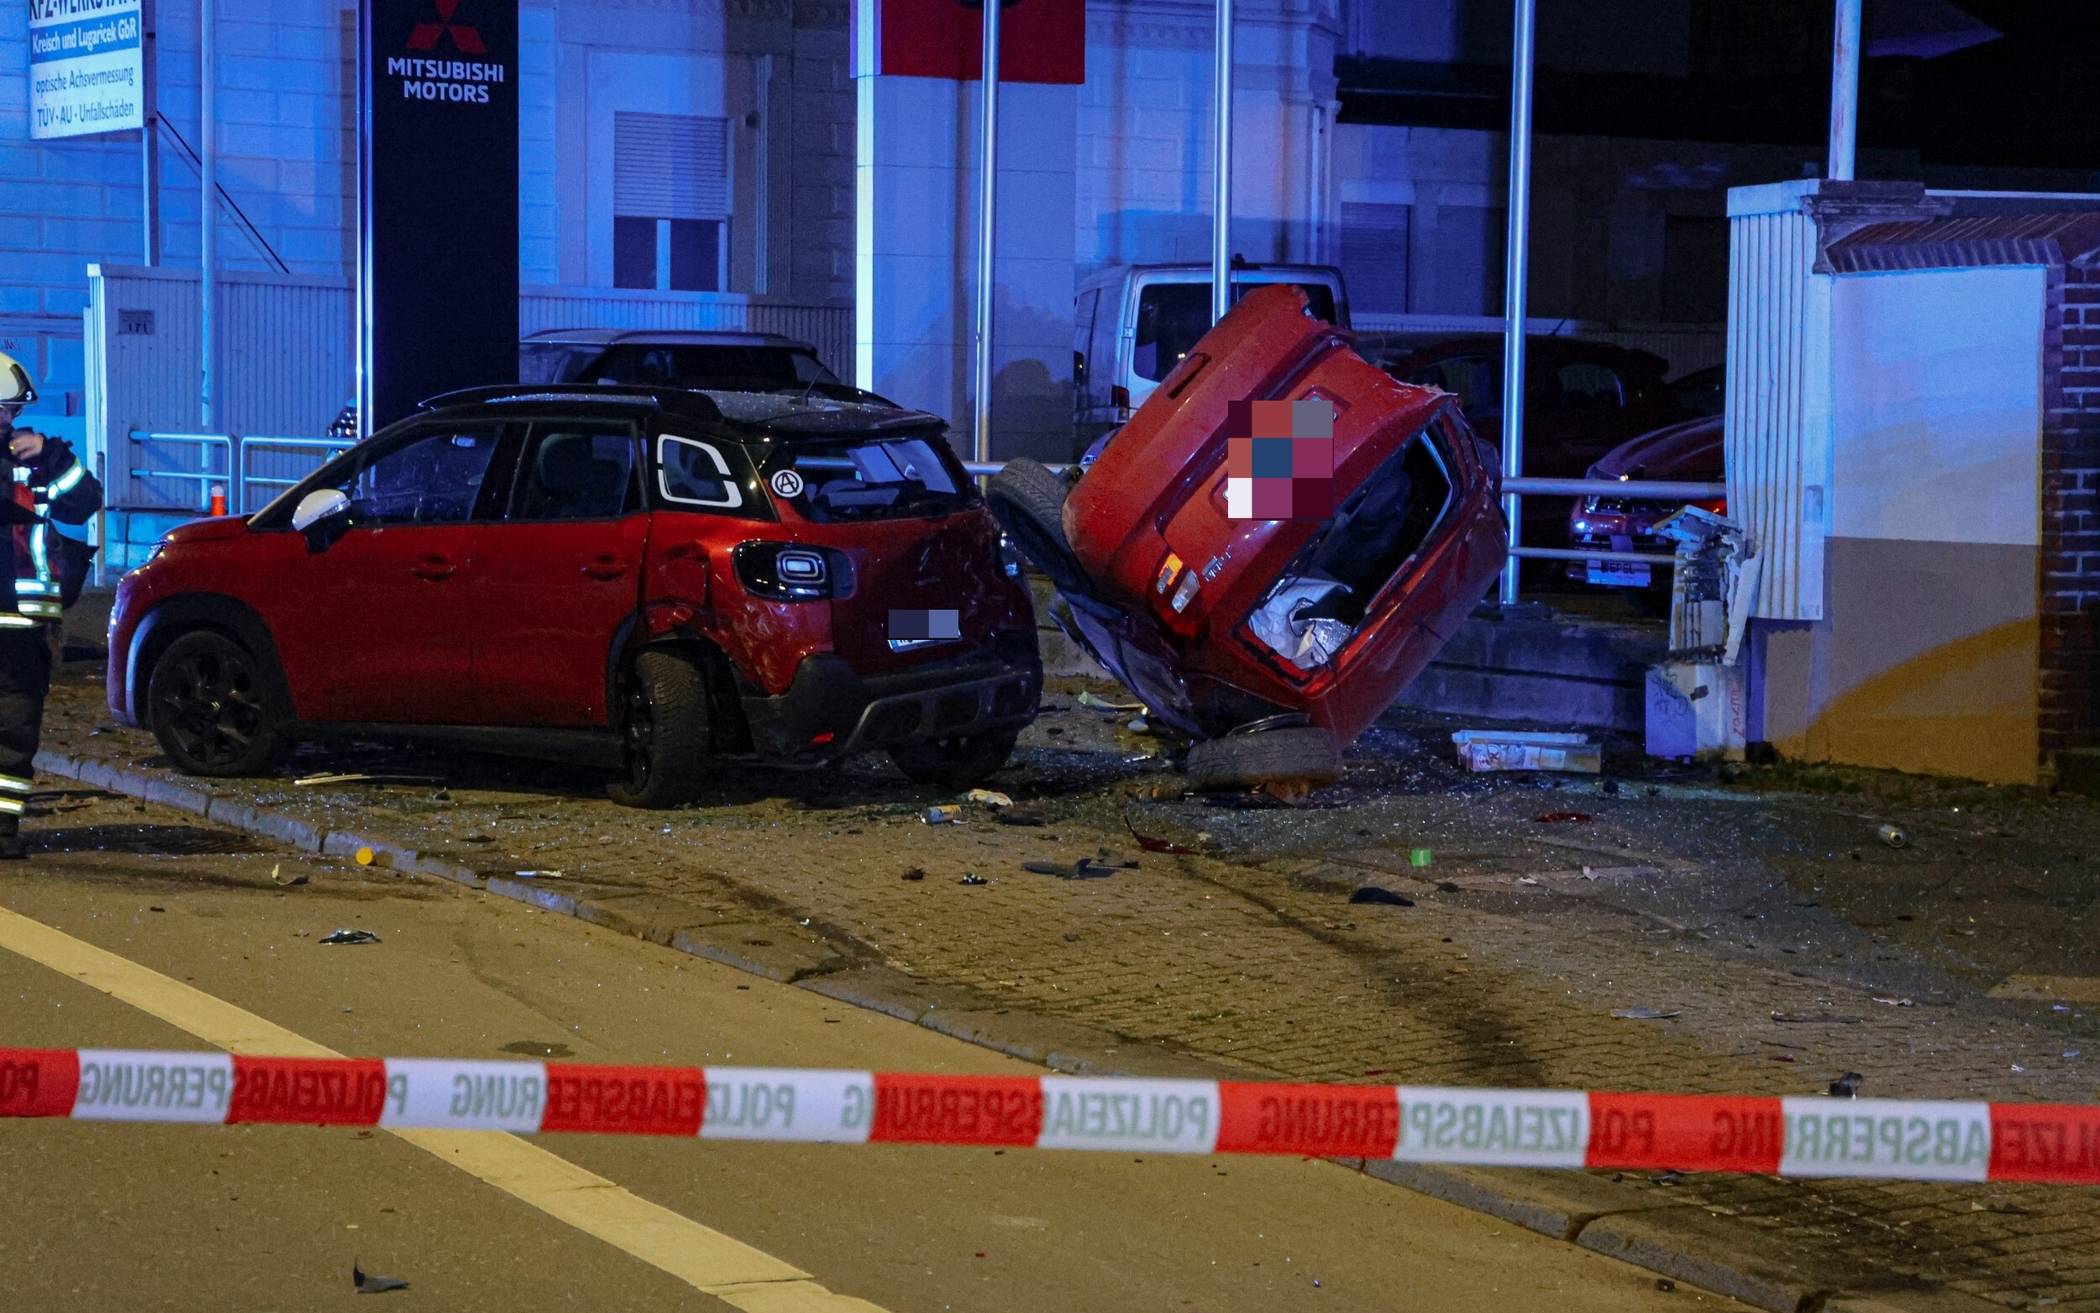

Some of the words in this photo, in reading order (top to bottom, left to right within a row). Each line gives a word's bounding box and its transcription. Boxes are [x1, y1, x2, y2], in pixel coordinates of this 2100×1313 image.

[32, 32, 61, 54] Kreisch
[62, 28, 77, 49] und
[118, 18, 137, 40] GbR
[388, 57, 504, 82] MITSUBISHI
[36, 73, 67, 98] optische
[69, 67, 134, 88] Achsvermessung
[403, 80, 489, 104] MOTORS
[79, 98, 134, 122] Unfallschäden
[26, 391, 32, 401] 3
